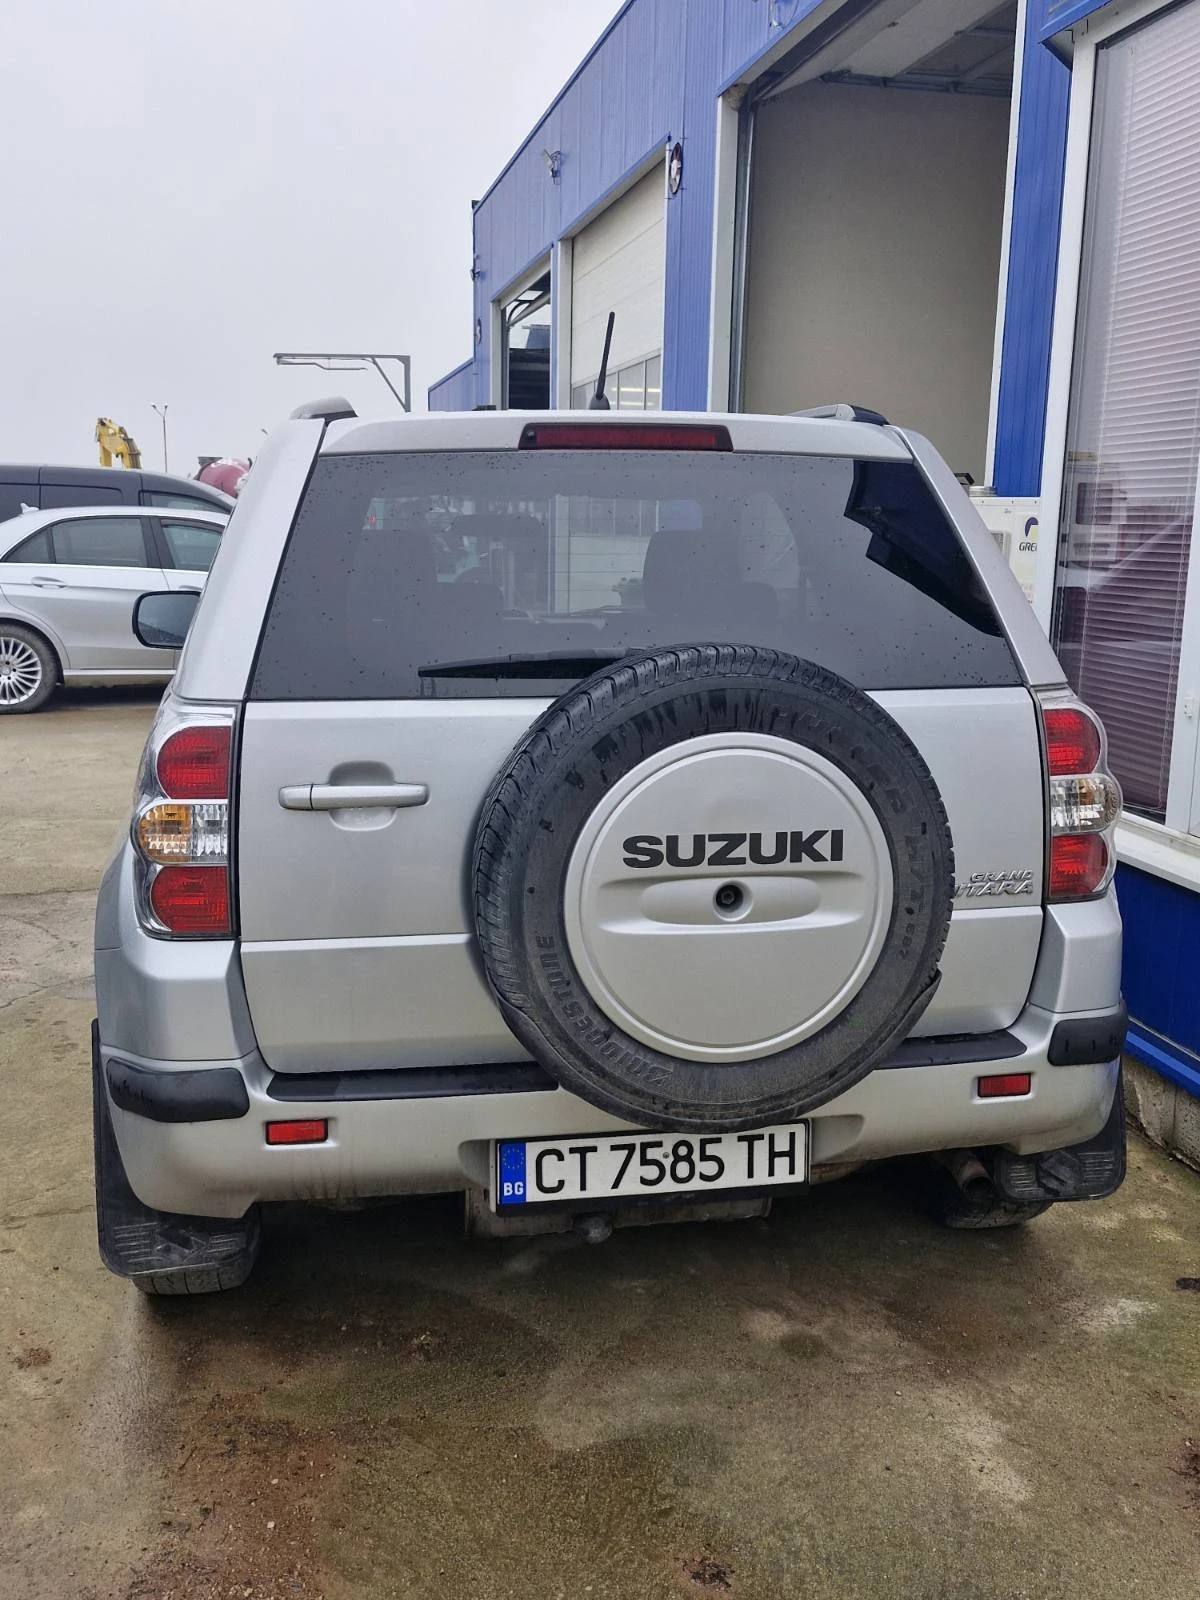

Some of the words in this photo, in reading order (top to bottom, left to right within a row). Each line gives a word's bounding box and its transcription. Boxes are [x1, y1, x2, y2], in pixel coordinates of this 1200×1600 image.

[1019, 541, 1038, 552] GRE
[622, 829, 844, 869] SUZUKI
[970, 869, 1033, 883] GRAND
[955, 879, 1033, 898] ITARA
[535, 1145, 598, 1194] CT
[610, 1137, 725, 1190] 7585
[737, 1131, 796, 1179] TH
[503, 1181, 524, 1196] BG
